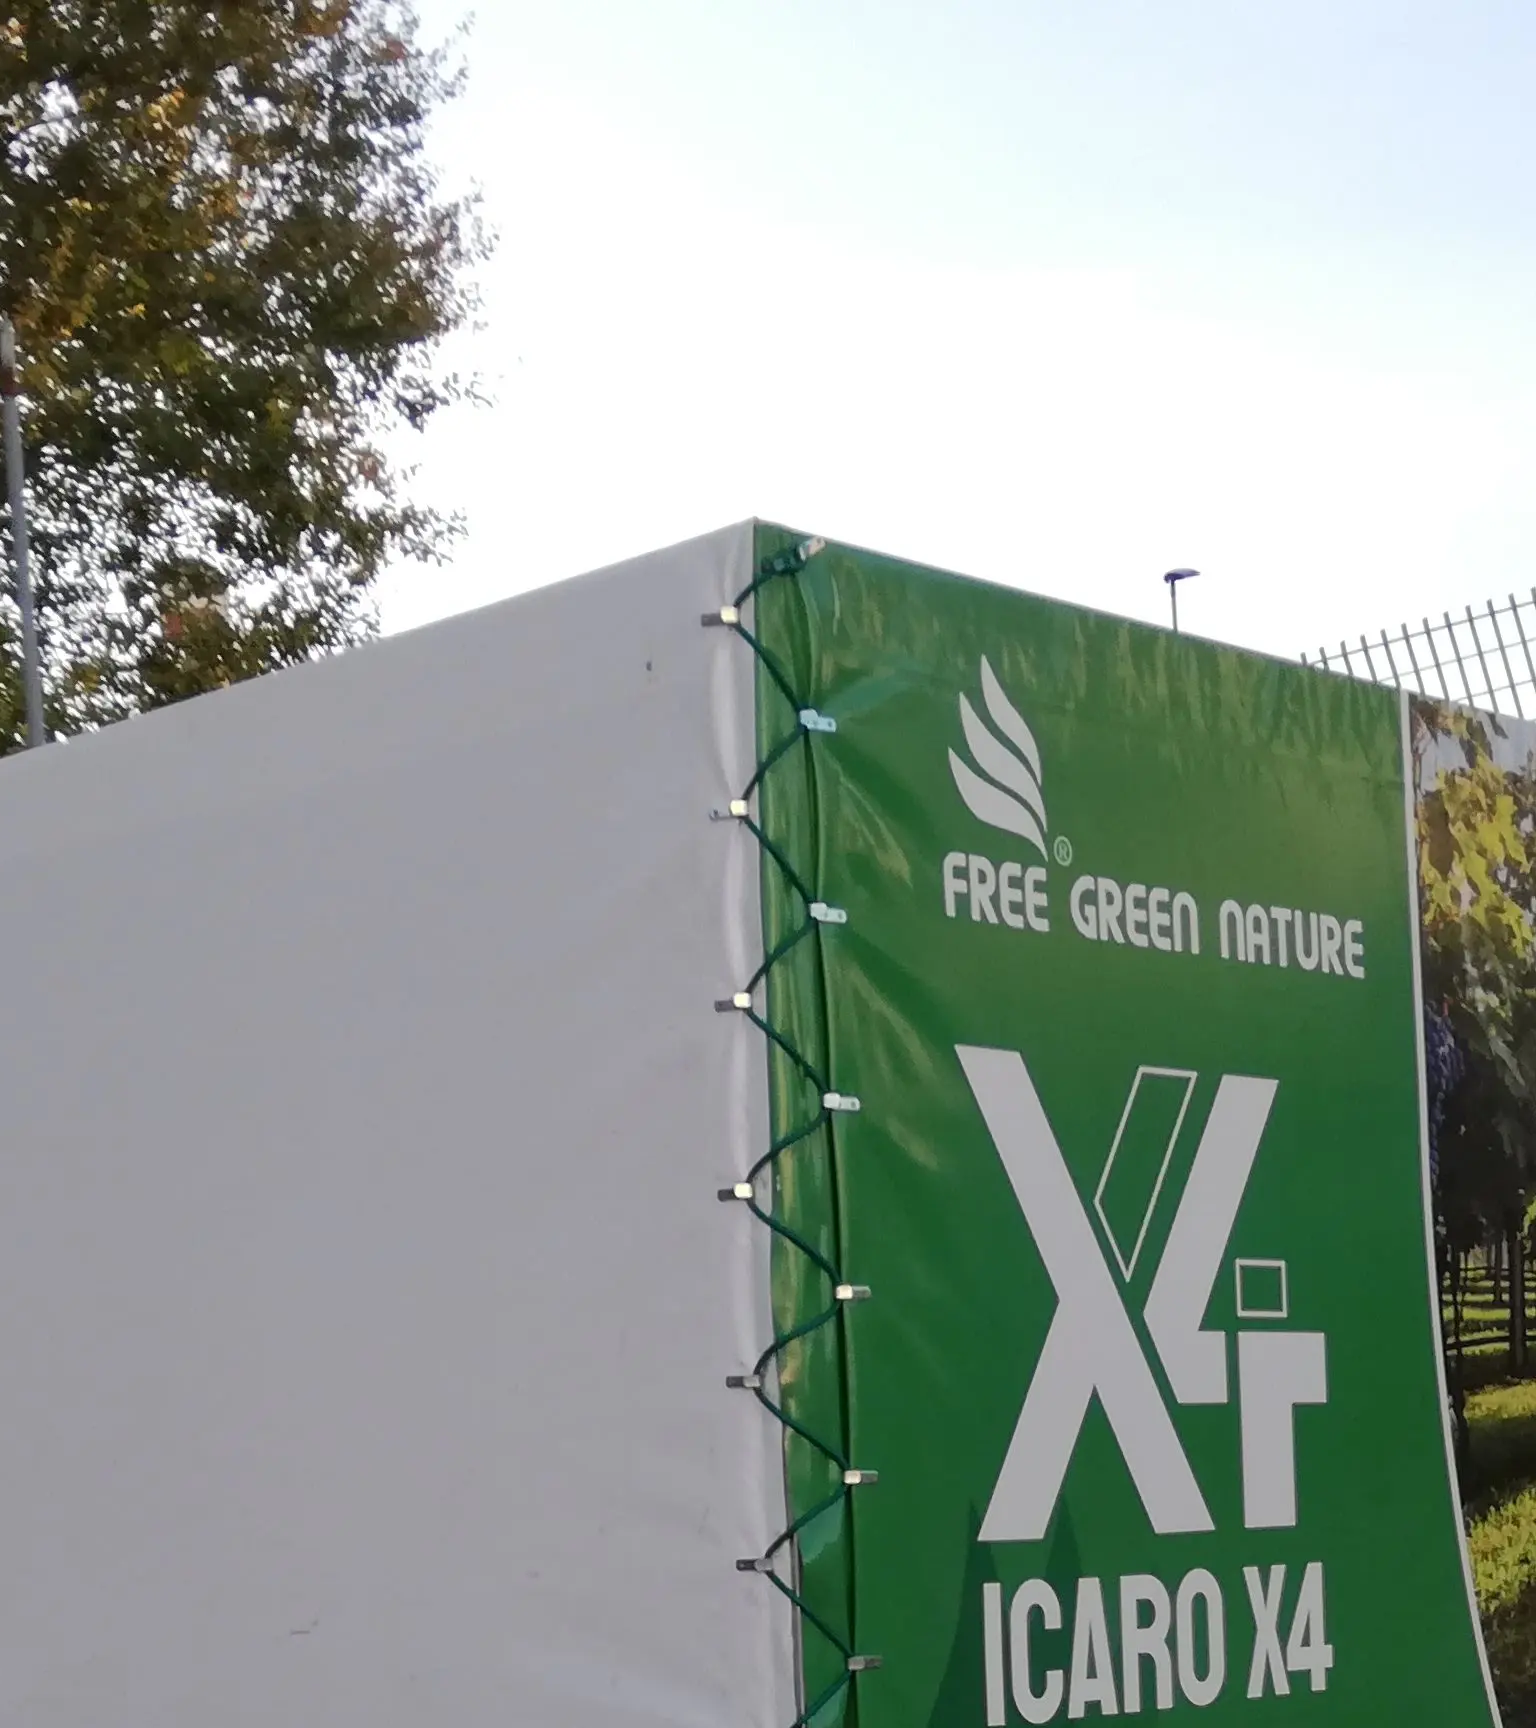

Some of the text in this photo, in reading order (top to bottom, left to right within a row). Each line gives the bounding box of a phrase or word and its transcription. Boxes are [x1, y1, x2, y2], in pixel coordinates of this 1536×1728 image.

[942, 851, 1366, 979] FREE GREEN NATURE
[983, 1561, 1334, 1728] ICARO X4
